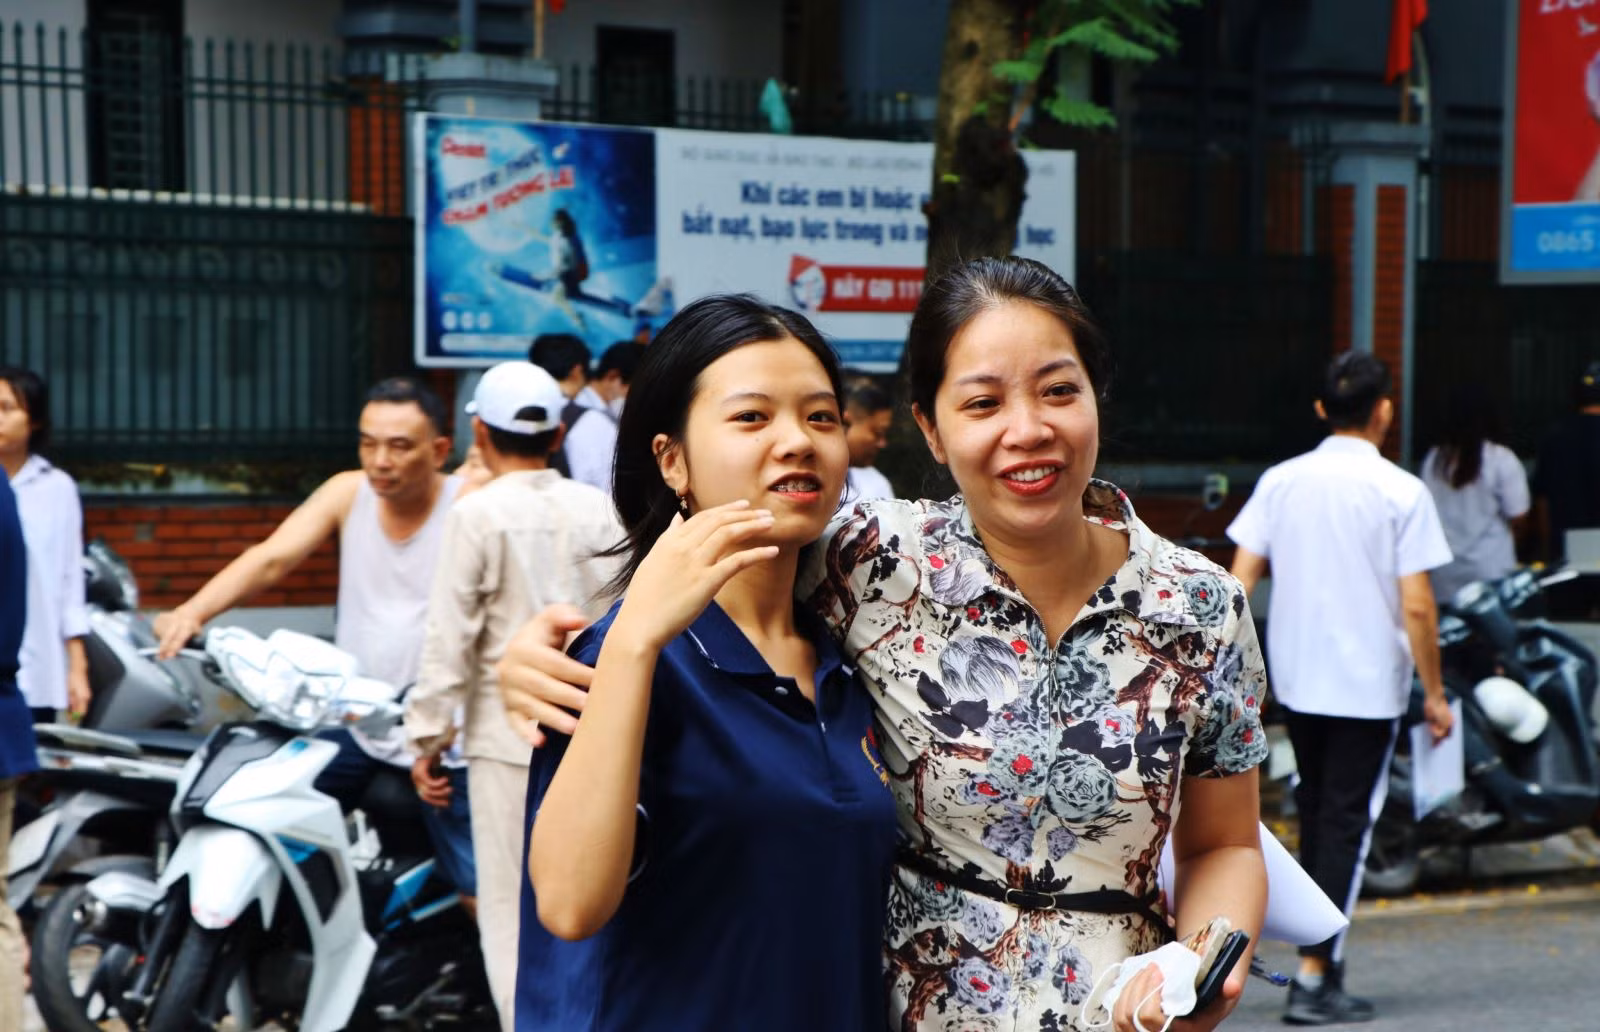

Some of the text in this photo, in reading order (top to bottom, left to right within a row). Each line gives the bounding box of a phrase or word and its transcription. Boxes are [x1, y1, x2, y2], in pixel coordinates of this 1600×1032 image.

[741, 181, 772, 205] Khi
[777, 183, 810, 206] các
[817, 190, 844, 208] em
[851, 187, 866, 213] bị
[873, 187, 912, 213] hoặc
[761, 215, 794, 243] bạo
[802, 216, 828, 244] lực
[836, 219, 883, 245] trong
[890, 222, 908, 241] và
[1026, 224, 1054, 249] học
